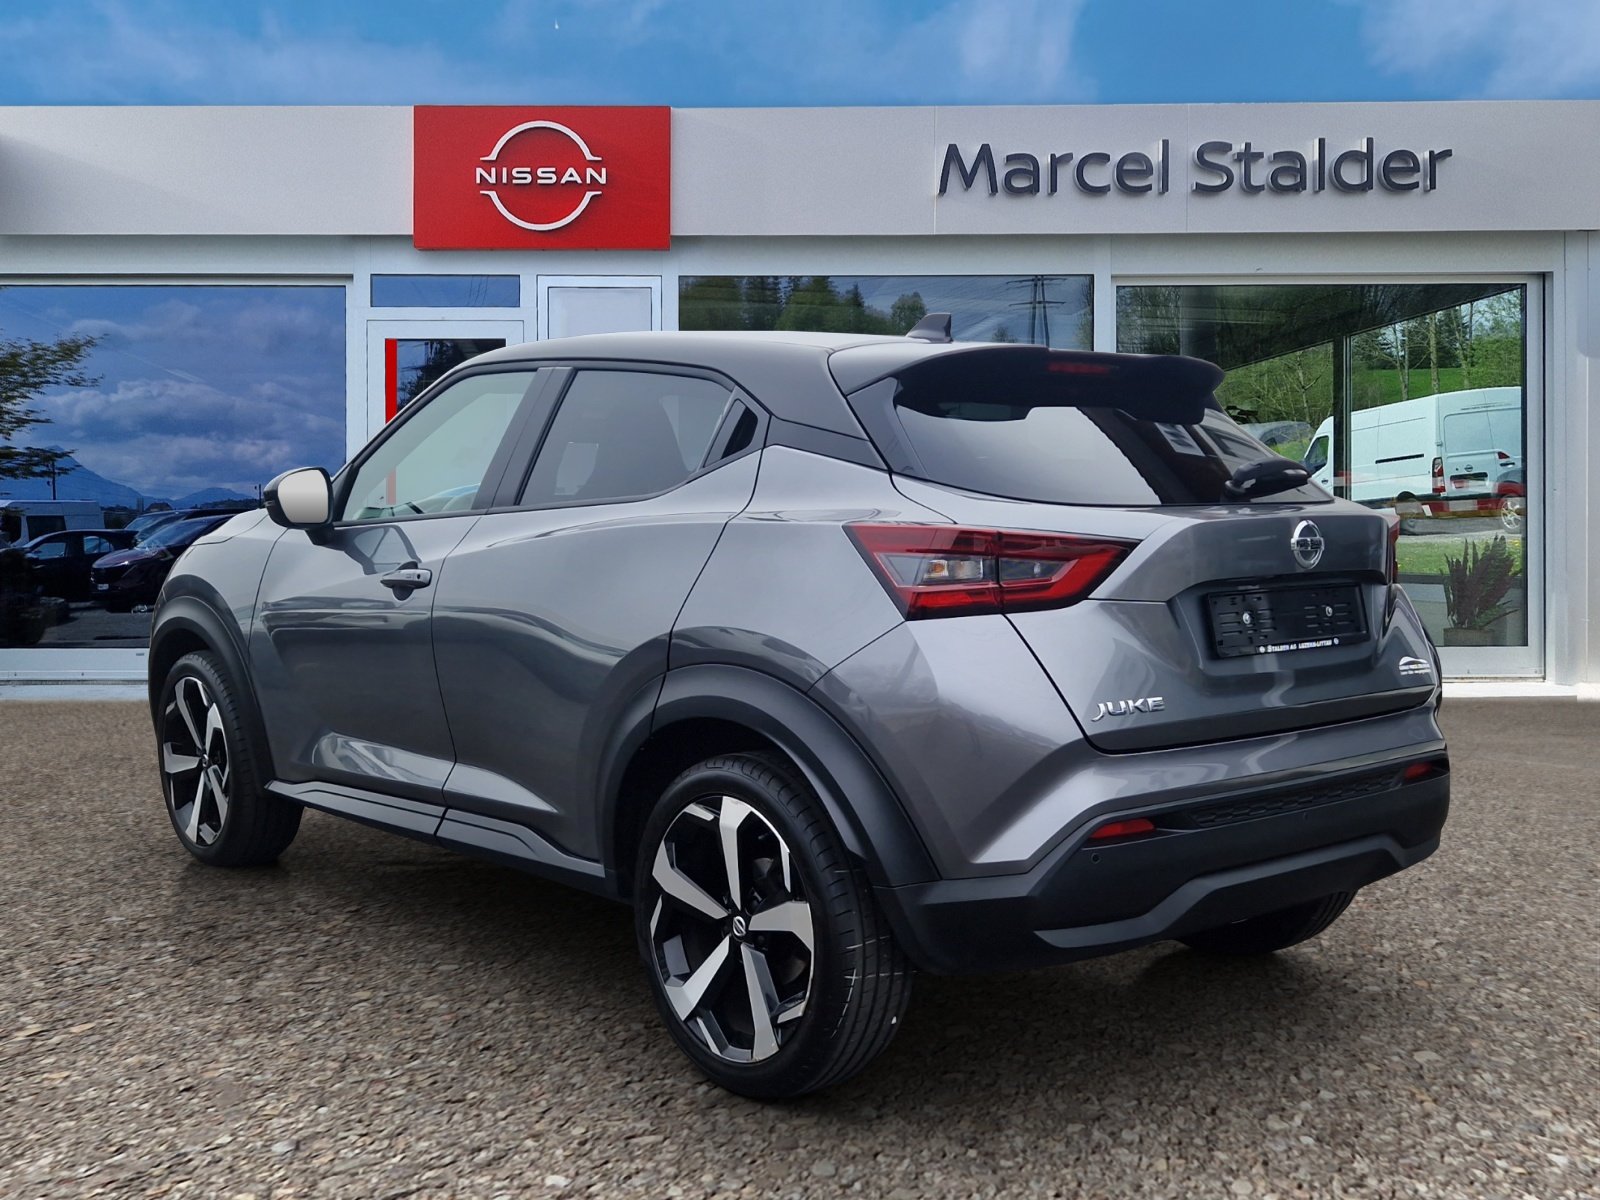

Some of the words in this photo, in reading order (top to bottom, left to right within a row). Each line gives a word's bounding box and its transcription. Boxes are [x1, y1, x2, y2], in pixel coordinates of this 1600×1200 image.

[475, 167, 607, 185] NISSAN
[938, 138, 1170, 197] Marcel
[1191, 137, 1453, 194] Stalder
[1091, 696, 1165, 722] JUKE
